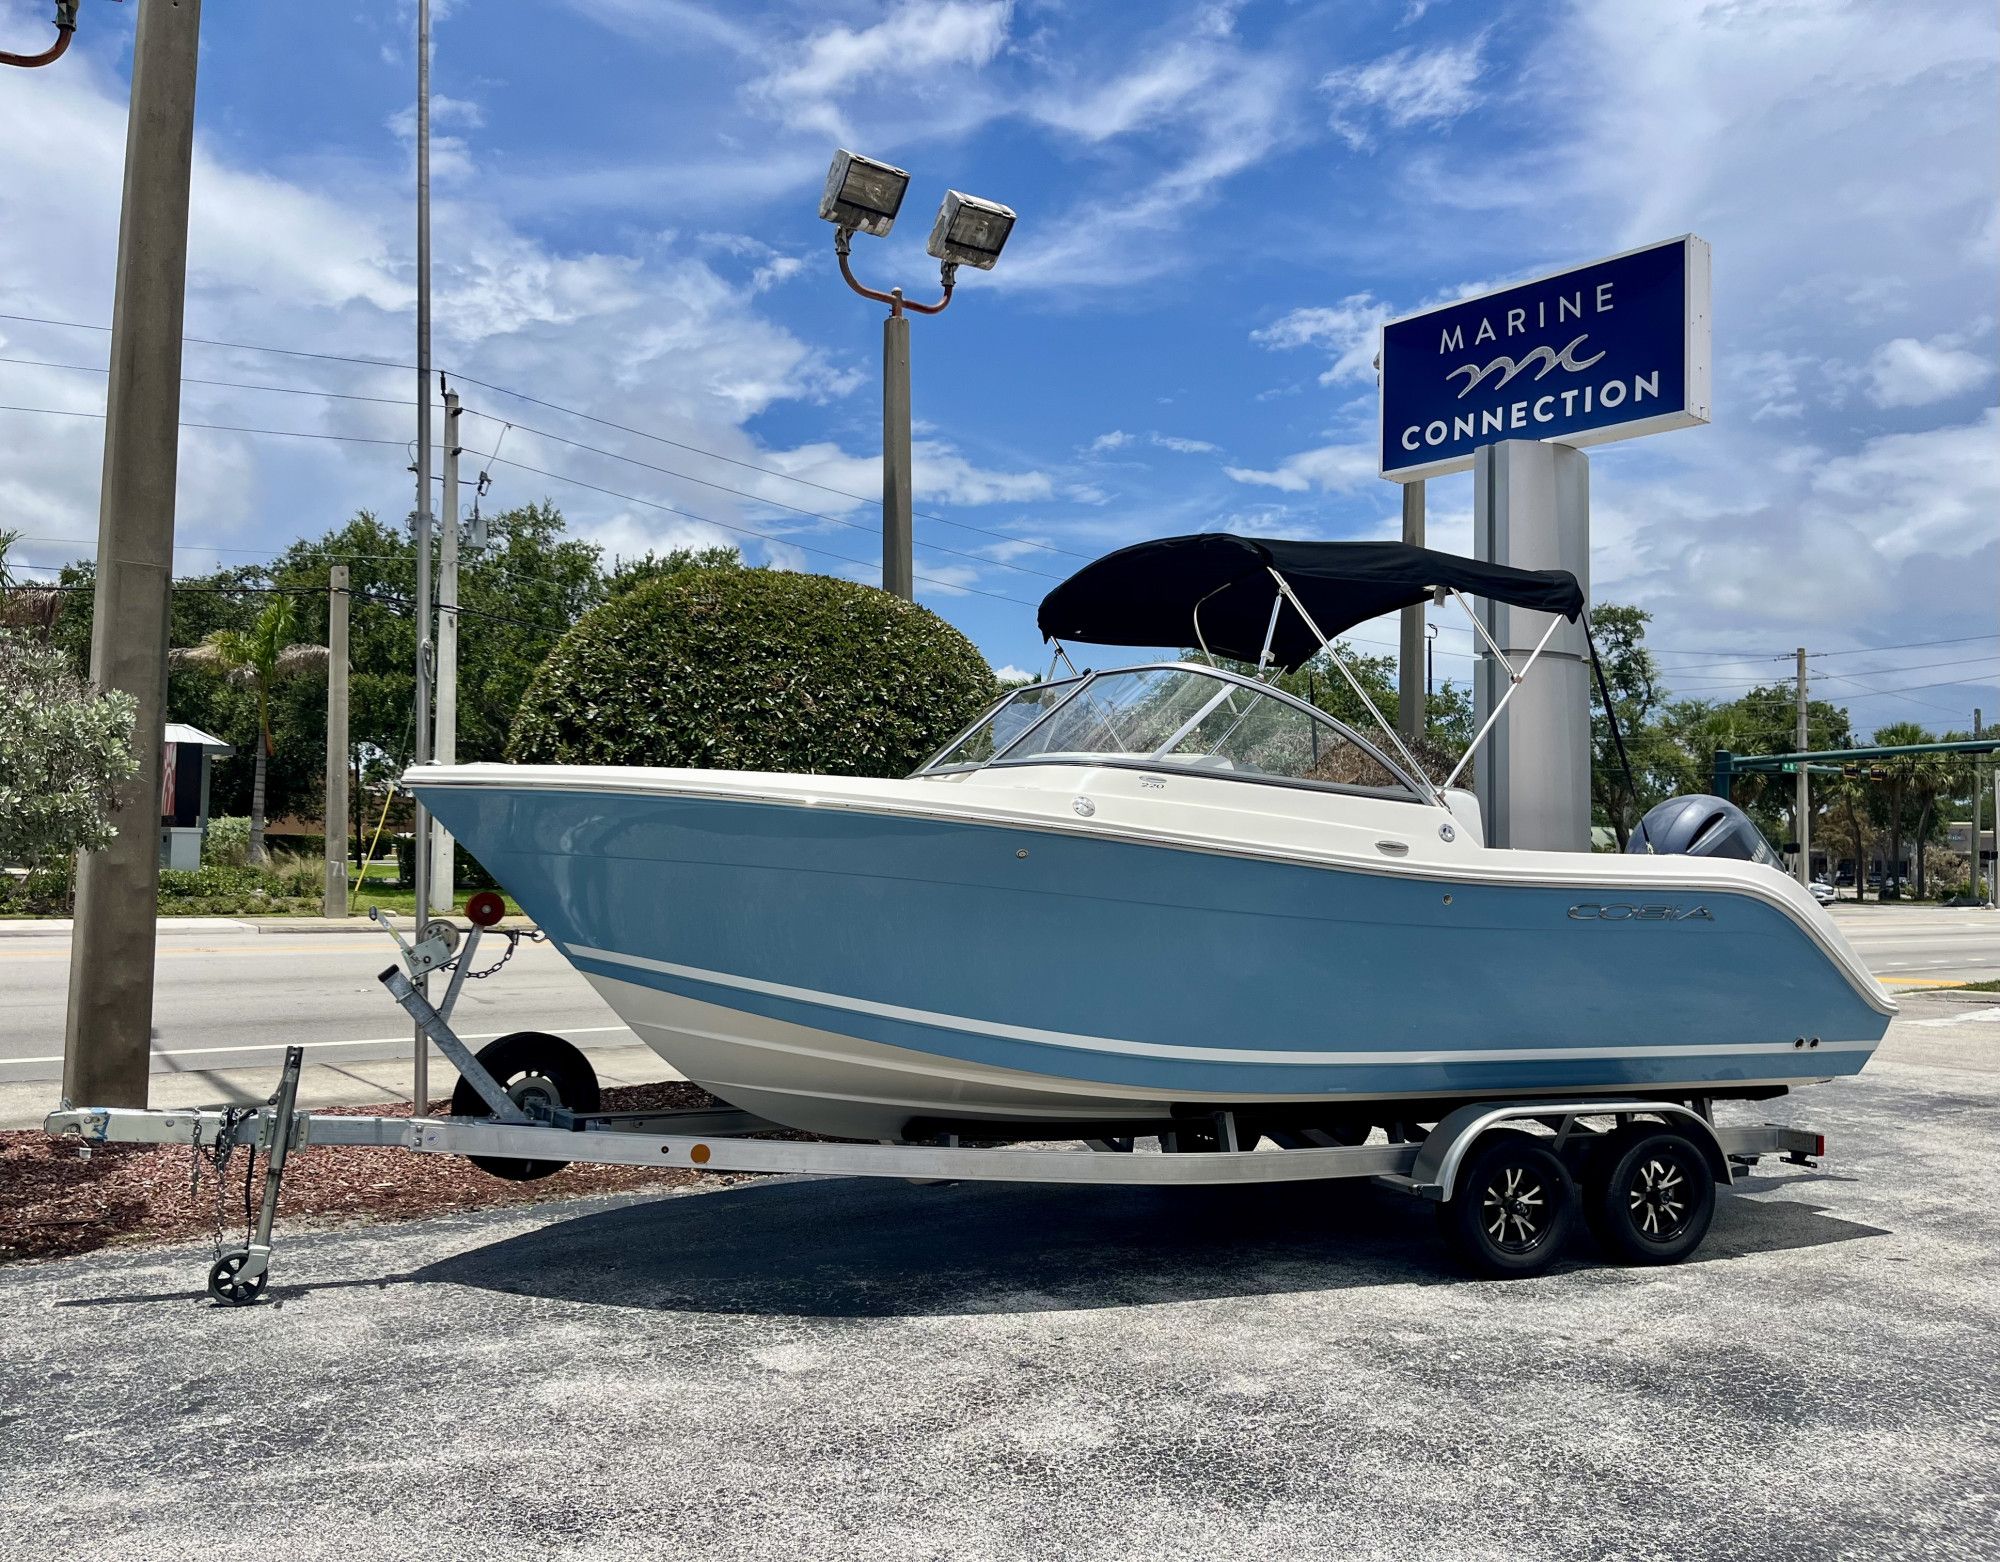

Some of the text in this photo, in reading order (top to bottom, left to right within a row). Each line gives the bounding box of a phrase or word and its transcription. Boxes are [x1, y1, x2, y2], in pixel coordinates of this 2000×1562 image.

[1439, 282, 1614, 355] MARINE
[1401, 370, 1659, 451] CONNECTION
[1567, 903, 1715, 921] COBIA
